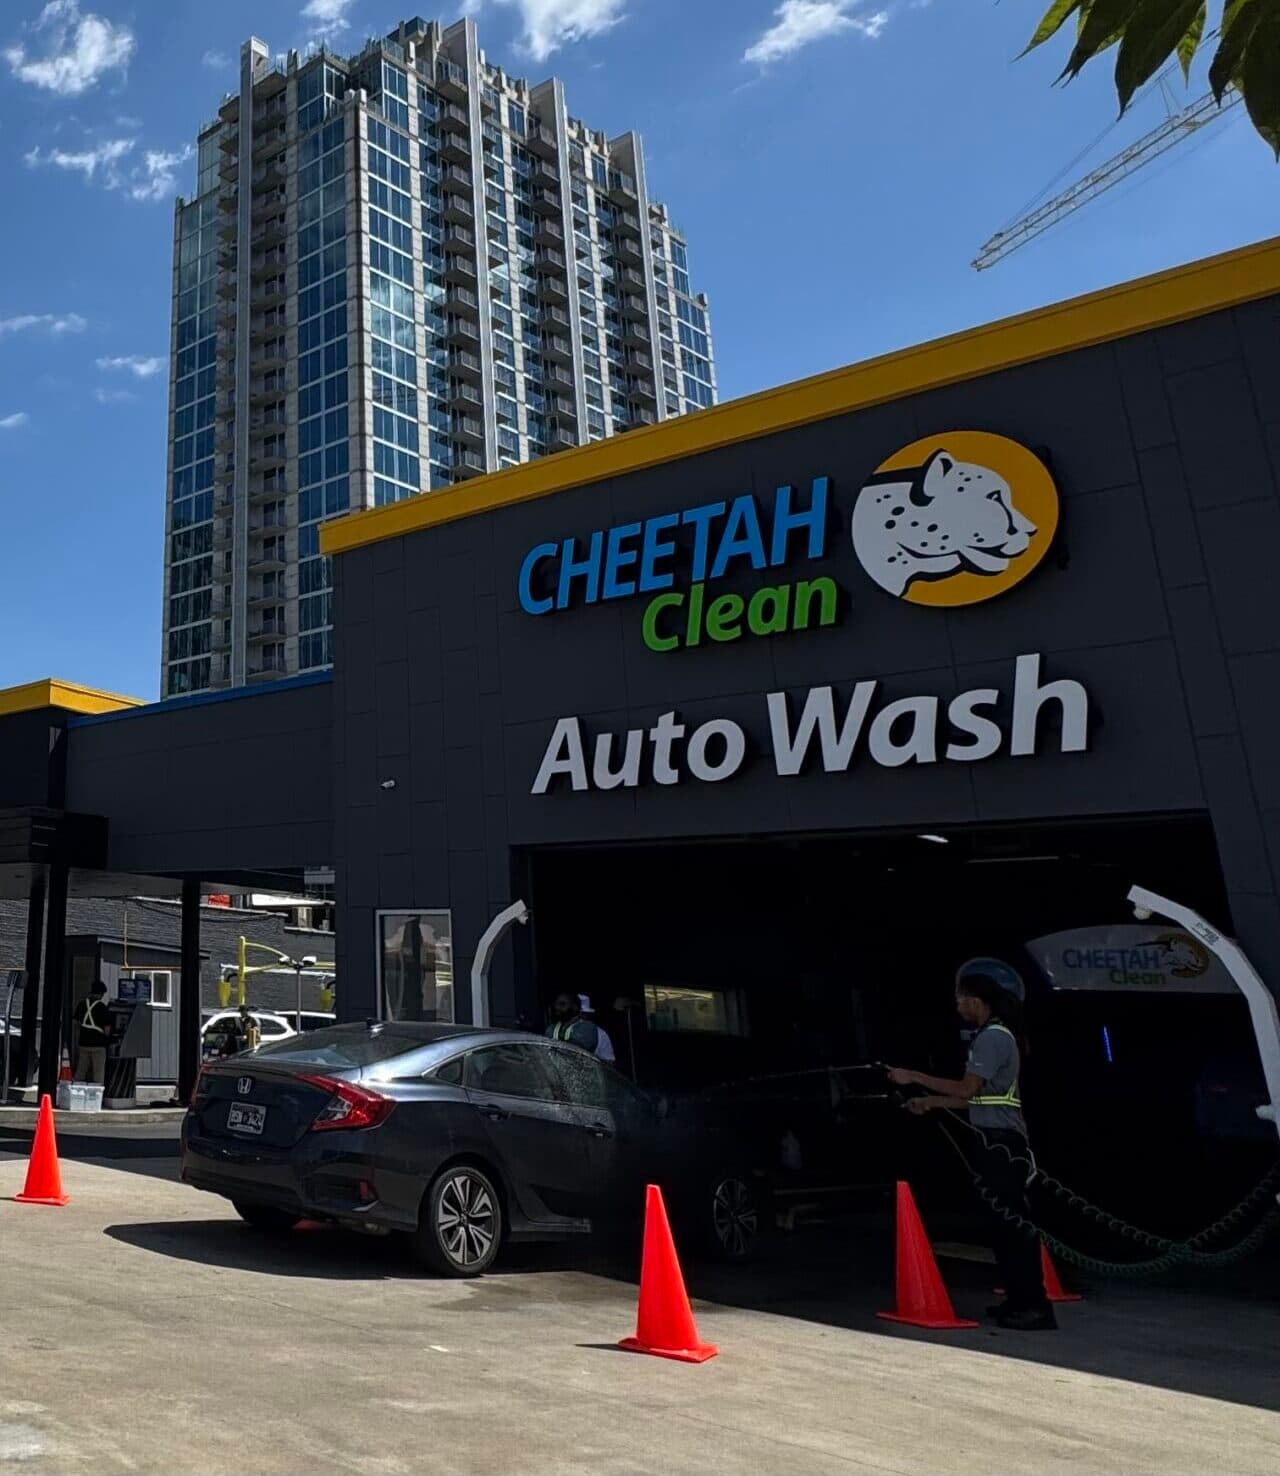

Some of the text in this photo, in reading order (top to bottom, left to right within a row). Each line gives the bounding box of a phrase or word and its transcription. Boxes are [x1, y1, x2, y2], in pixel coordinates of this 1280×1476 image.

[519, 476, 829, 616] CHEETAH
[642, 576, 838, 653] Clean
[531, 653, 1089, 794] Auto Wash
[1062, 949, 1159, 969] CHEETAH
[1109, 969, 1166, 984] Clean
